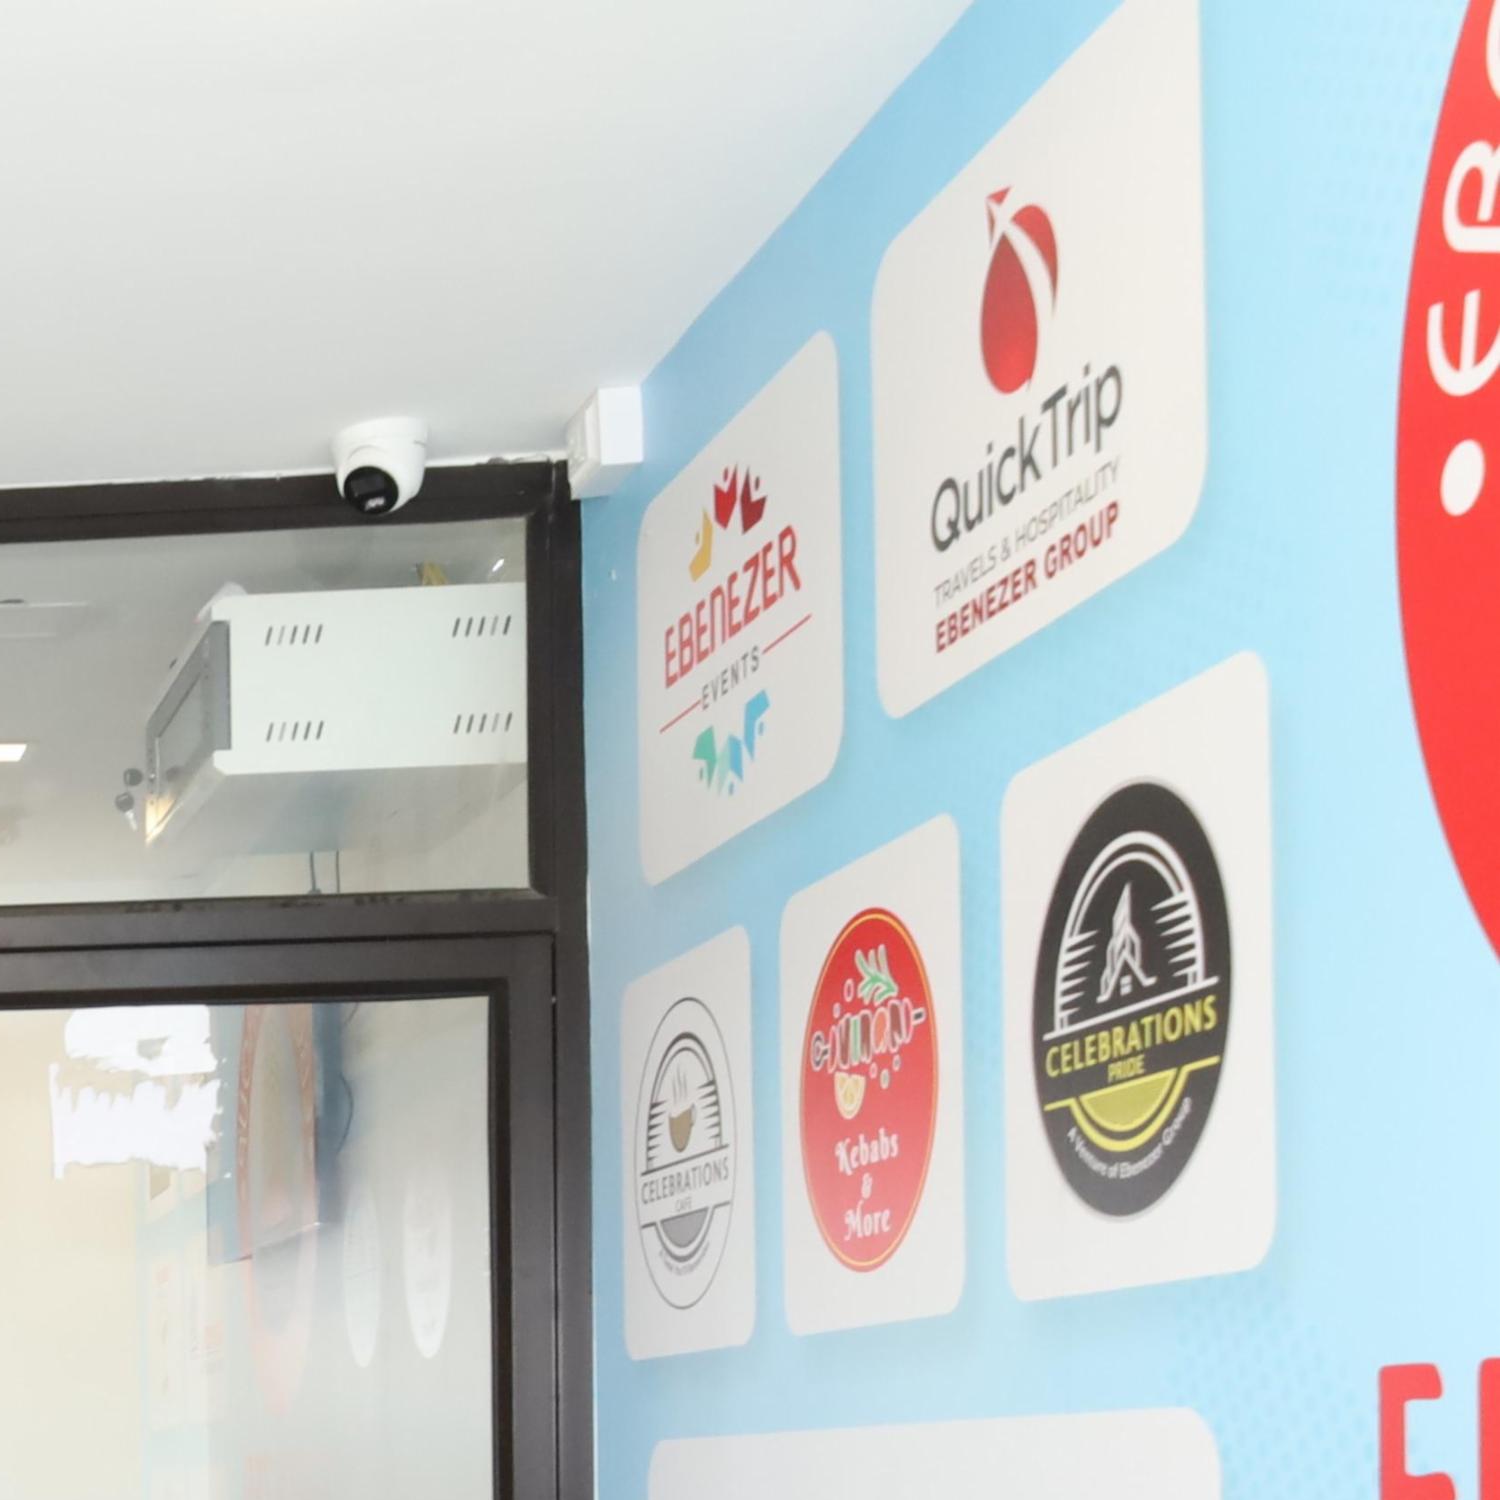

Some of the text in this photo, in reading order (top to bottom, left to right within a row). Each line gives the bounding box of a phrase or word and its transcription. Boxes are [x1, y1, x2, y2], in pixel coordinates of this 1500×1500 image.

[930, 361, 1123, 553] QuickTrip
[933, 455, 1122, 608] TRAVELS & HOSPITALITY
[664, 525, 802, 690] EBENEZER
[935, 500, 1119, 654] EBENEZER GROUP
[702, 645, 760, 711] EVENTS
[1045, 994, 1217, 1077] CELEBRATIONS
[1107, 1053, 1145, 1083] PRIDE
[641, 1157, 729, 1204] CELEBRATIONS
[835, 1128, 898, 1176] Kebabs
[844, 1200, 891, 1240] More
